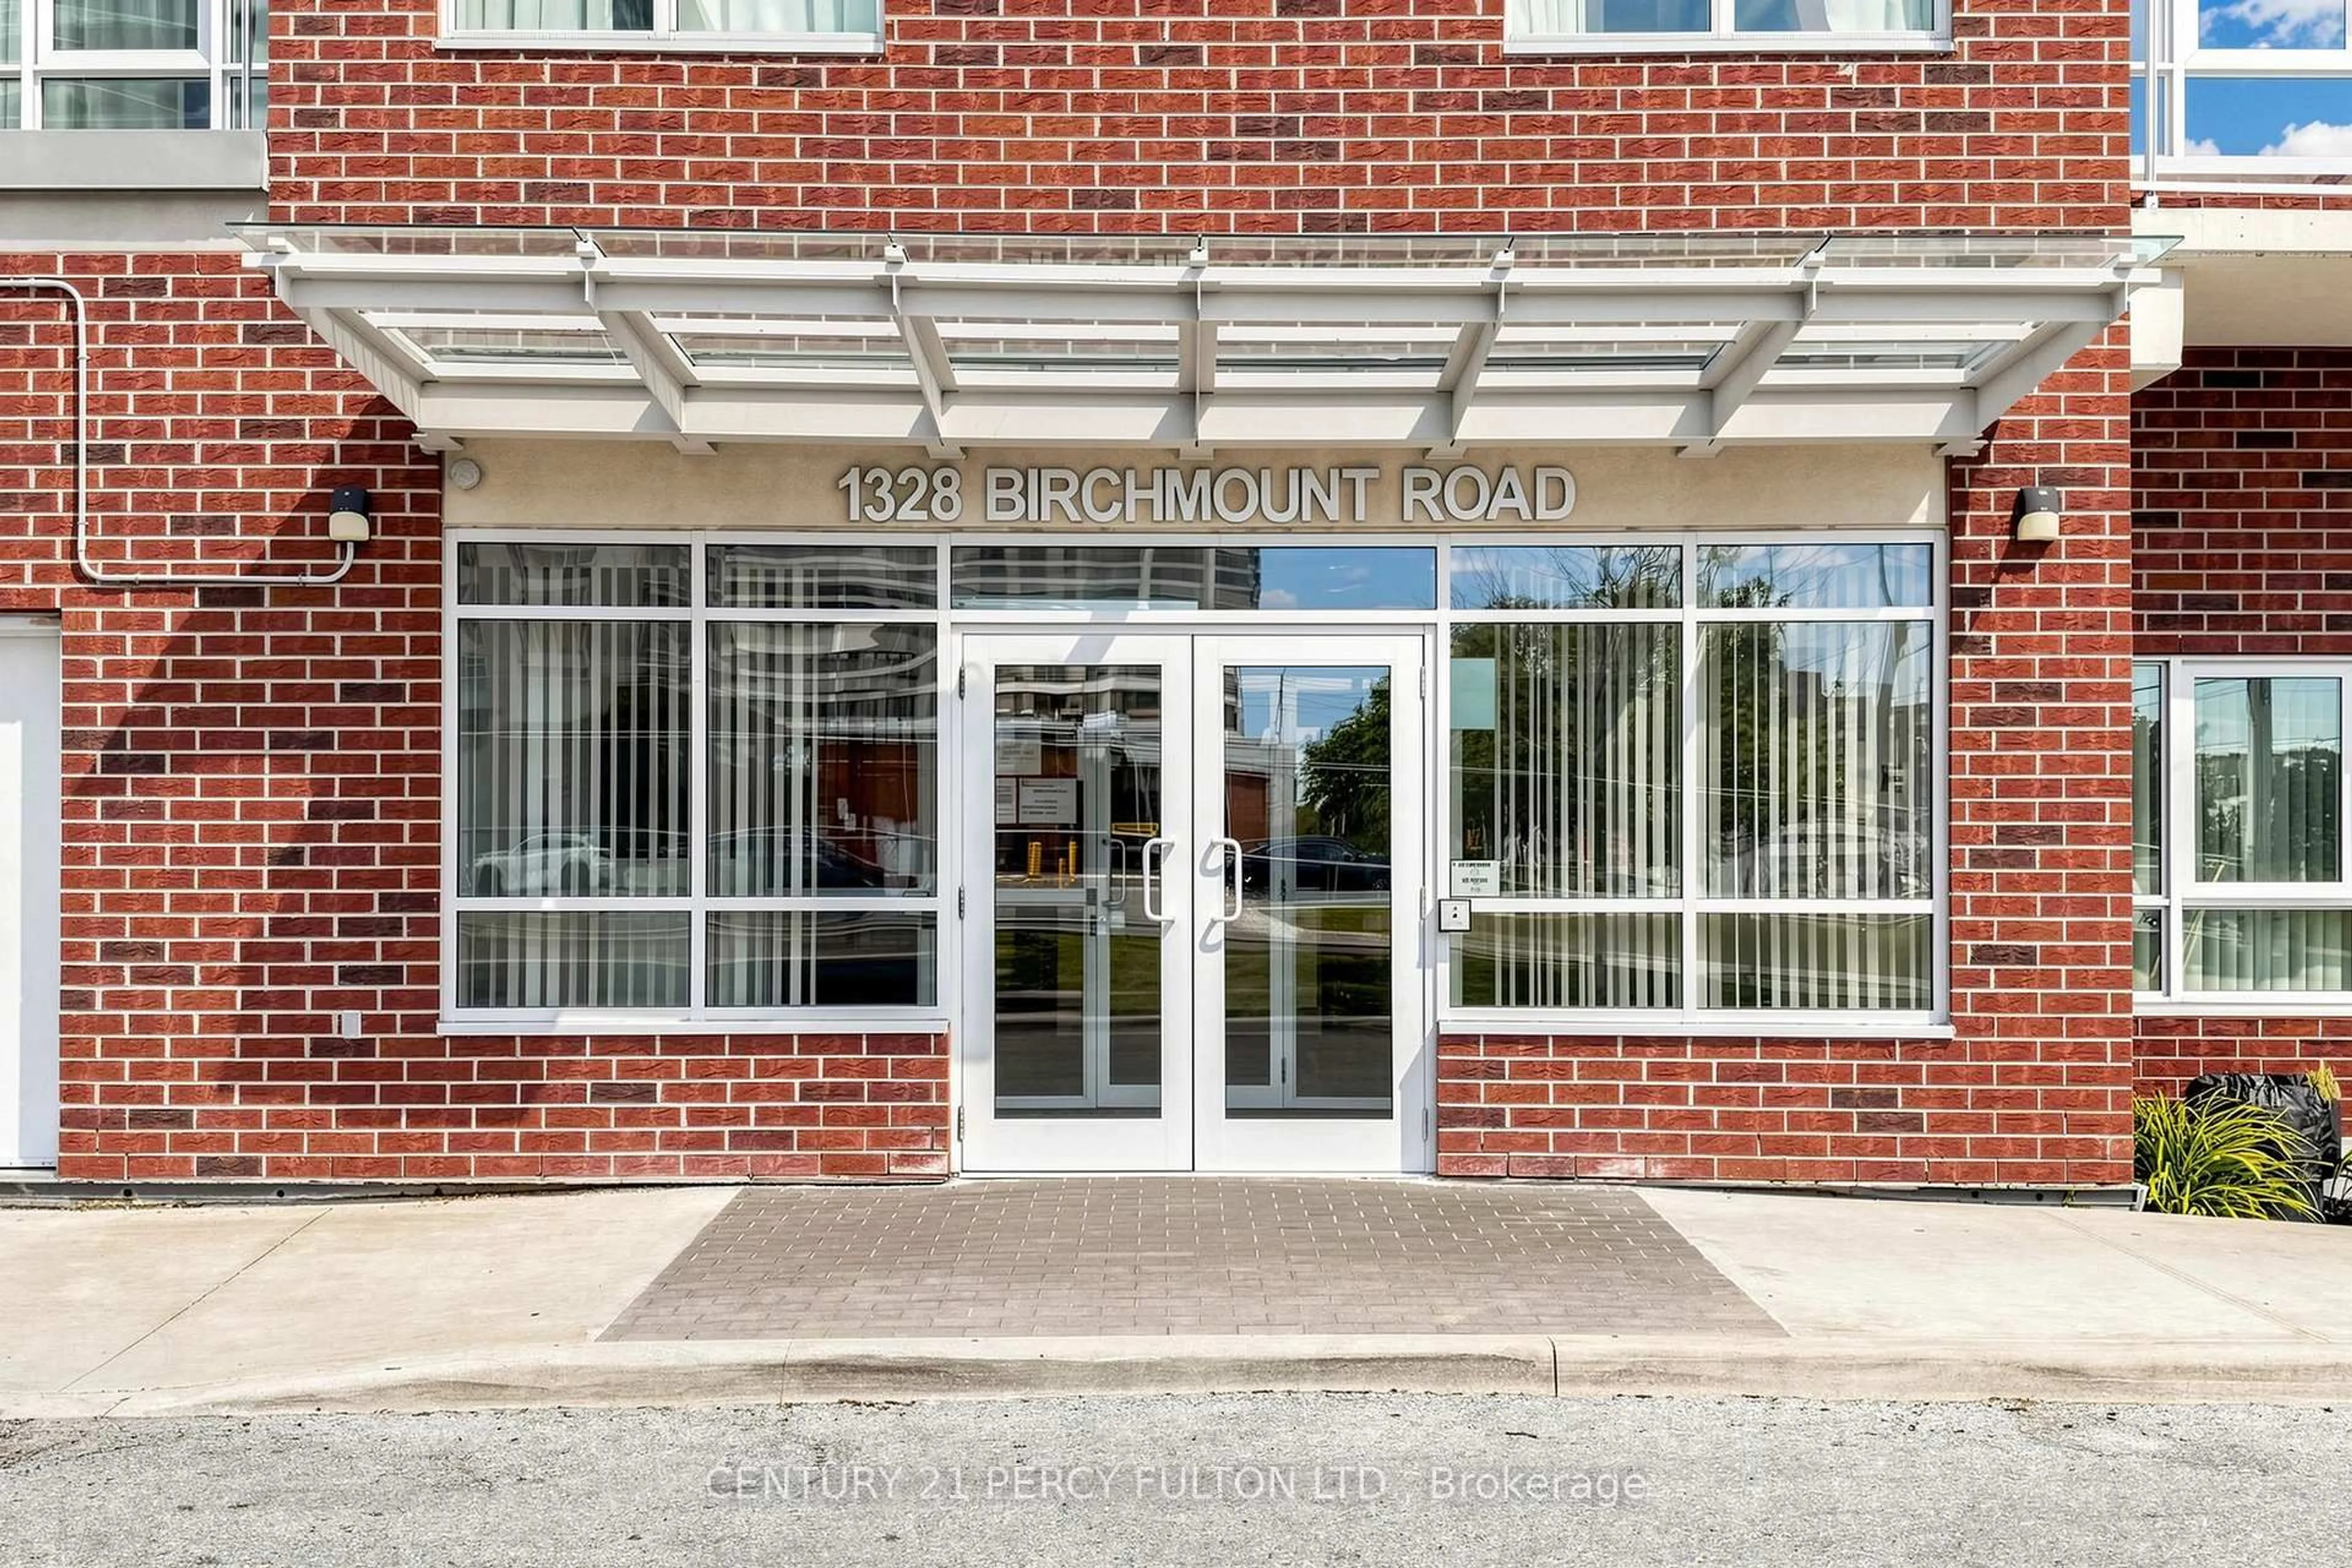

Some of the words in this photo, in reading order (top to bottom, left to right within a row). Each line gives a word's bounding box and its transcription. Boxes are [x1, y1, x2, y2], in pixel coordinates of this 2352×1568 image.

[837, 467, 963, 522] 1328
[986, 467, 1379, 522] BIRCHMOUNT
[1403, 466, 1577, 521] ROAD
